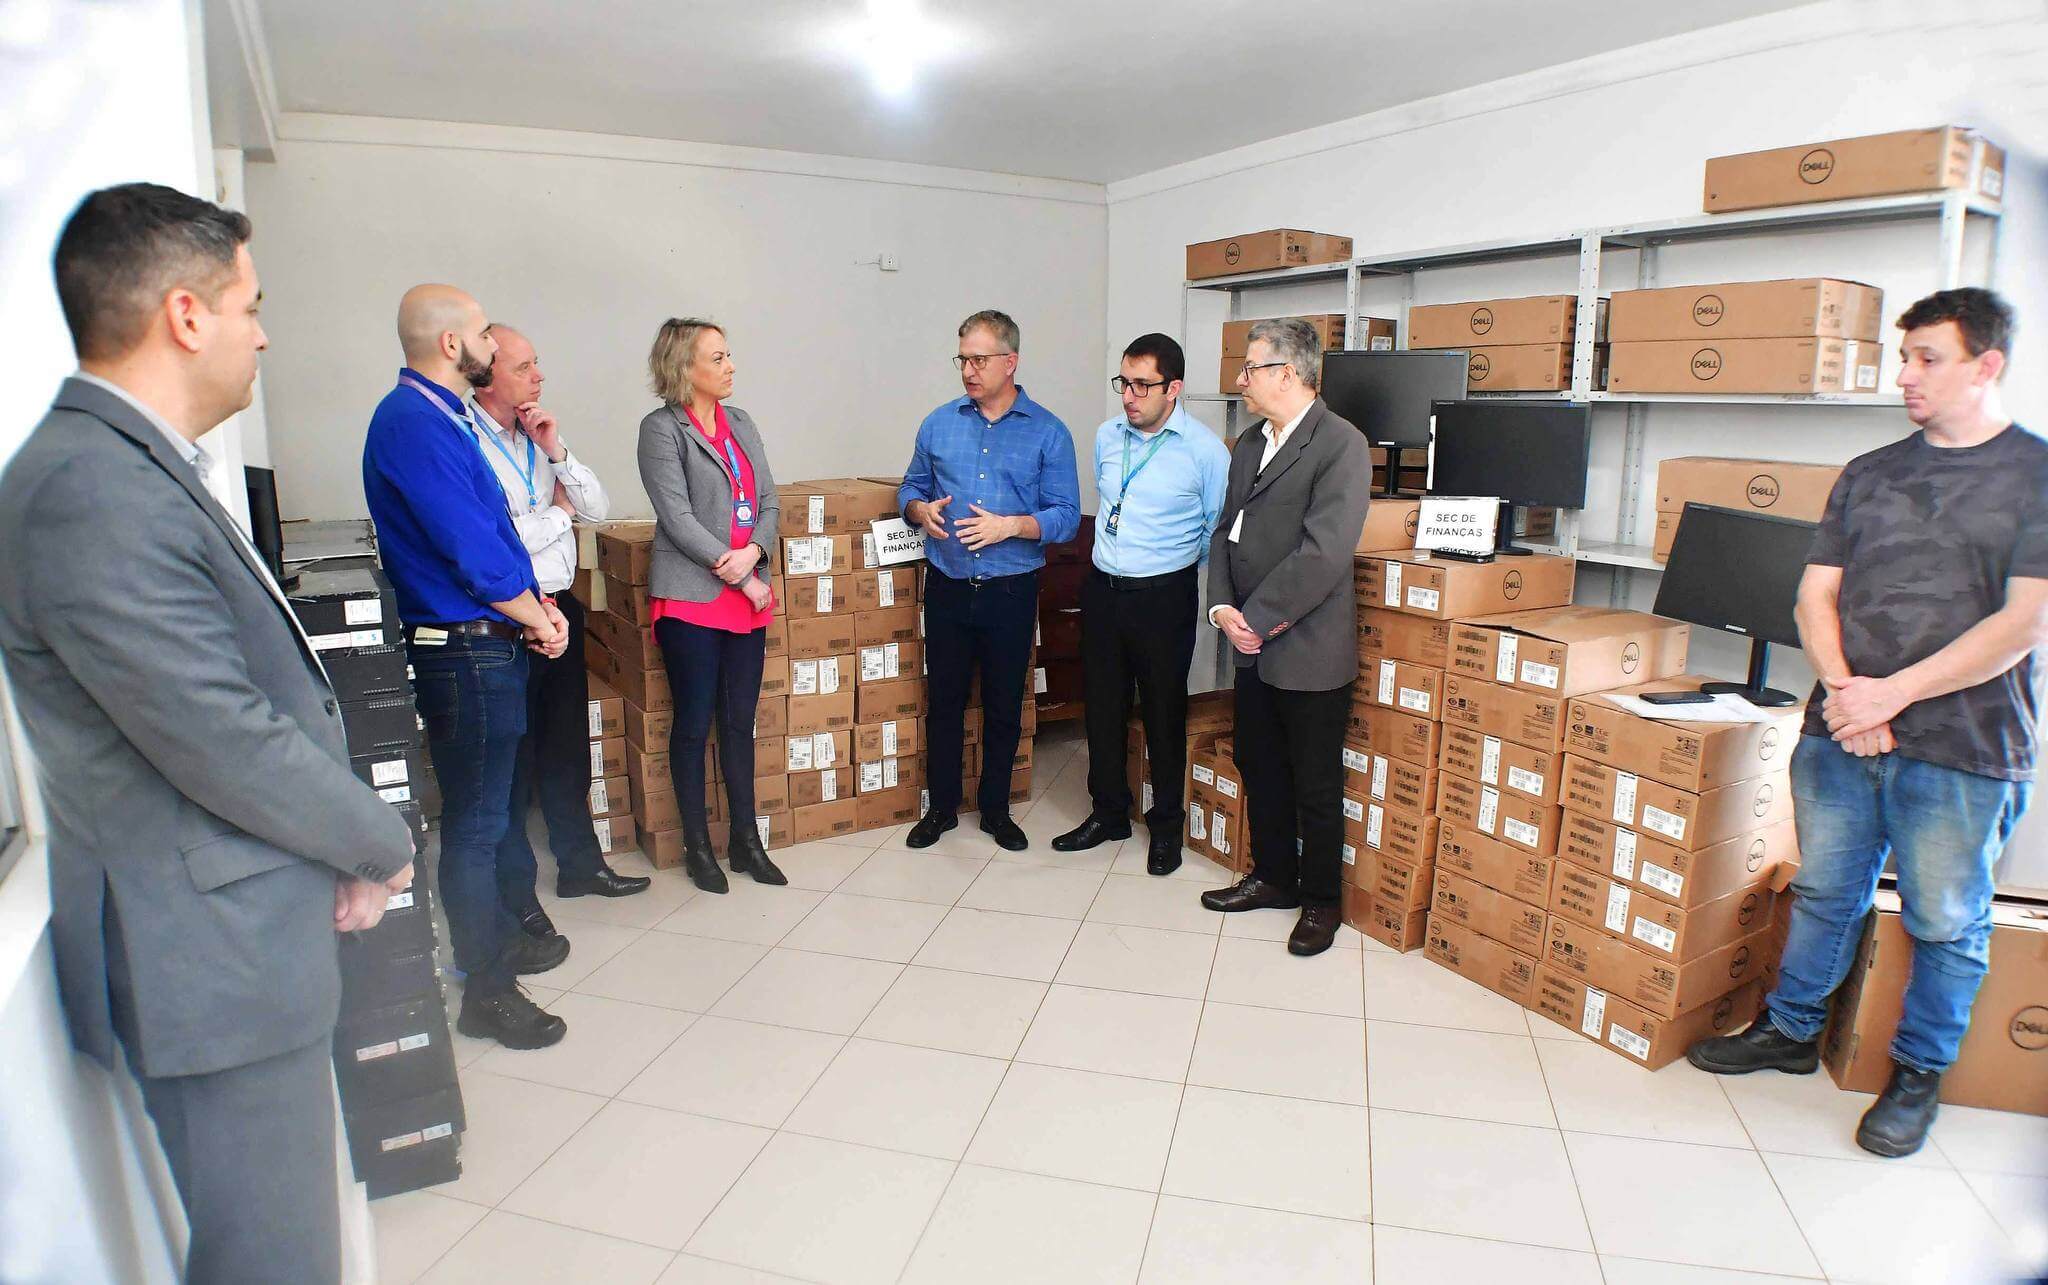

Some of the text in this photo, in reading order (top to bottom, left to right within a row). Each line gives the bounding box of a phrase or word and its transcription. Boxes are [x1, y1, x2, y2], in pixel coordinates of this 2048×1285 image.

[1803, 161, 1830, 172] DELL
[1696, 306, 1721, 315] DELL
[1473, 318, 1491, 326] DELL
[1694, 360, 1718, 369] DELL
[1750, 486, 1776, 497] DELL
[1435, 513, 1477, 523] SEC DE
[886, 529, 920, 541] SEC DE
[1505, 581, 1520, 590] DELL
